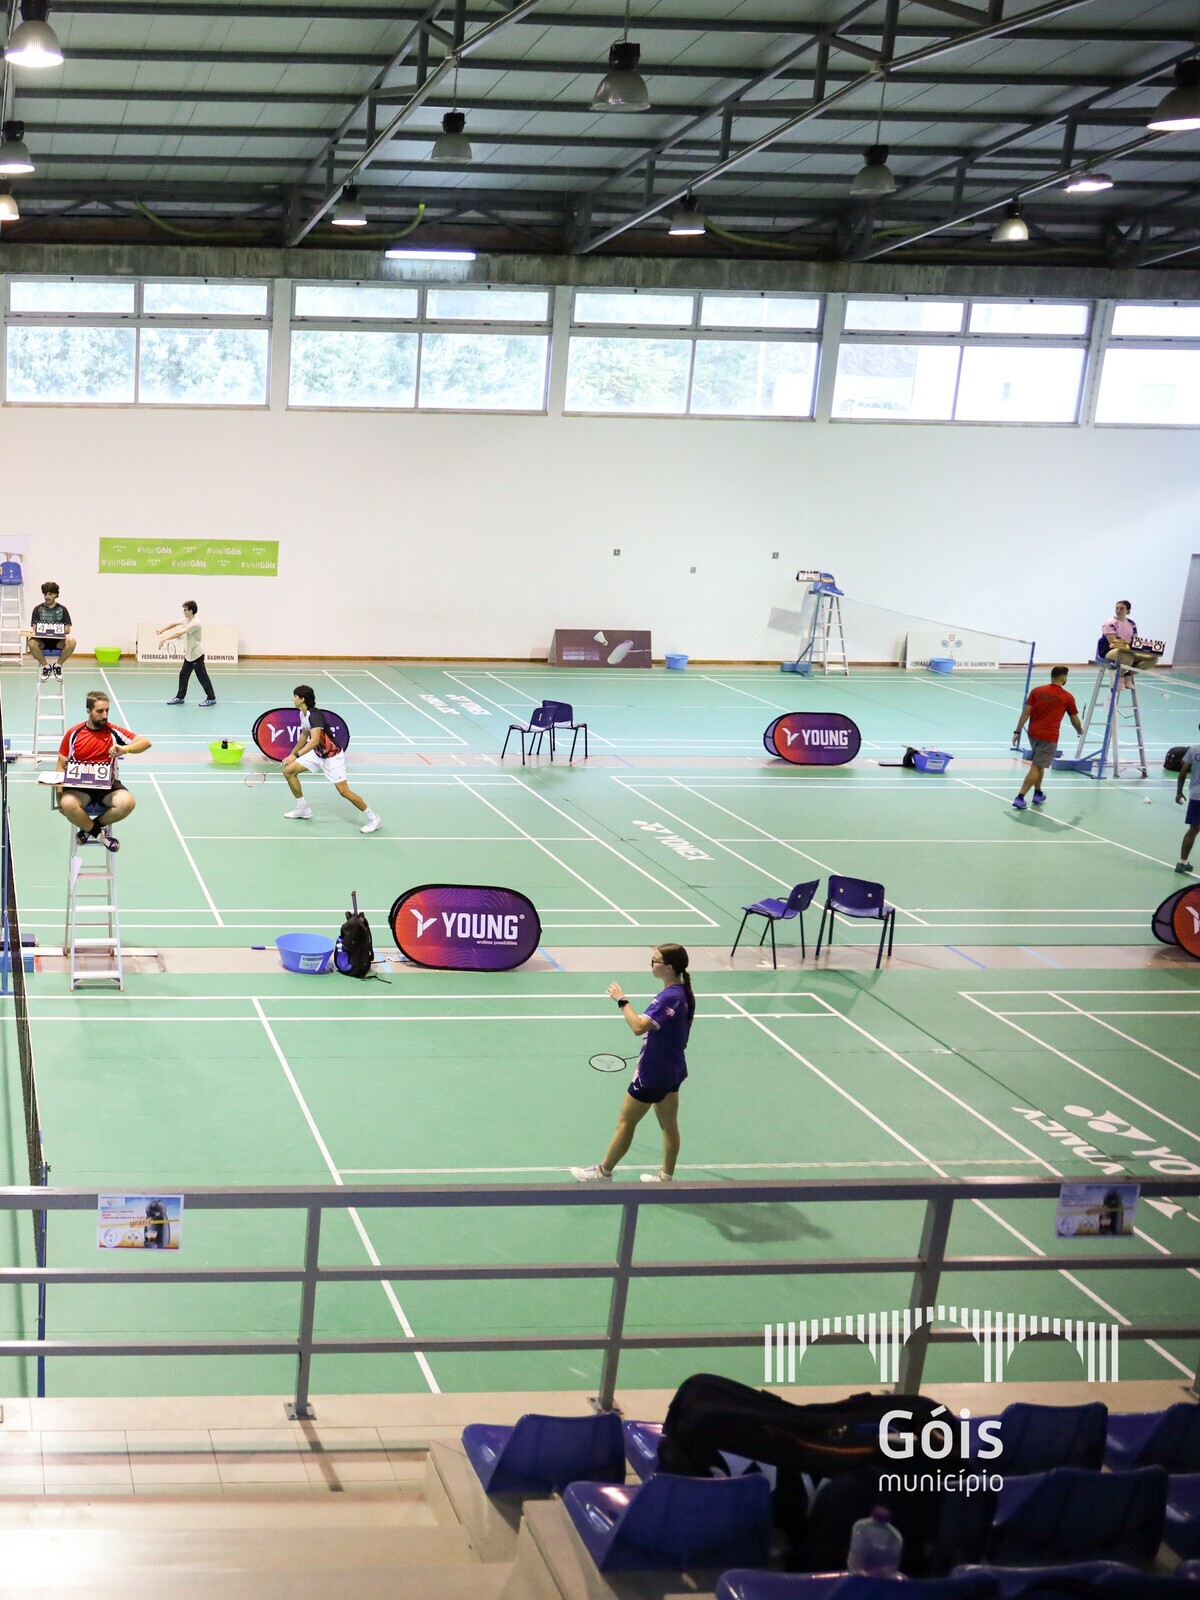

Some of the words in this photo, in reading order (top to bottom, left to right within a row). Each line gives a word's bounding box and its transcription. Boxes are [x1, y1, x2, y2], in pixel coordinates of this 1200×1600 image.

[137, 546, 172, 554] #VisitGóis
[207, 547, 242, 555] #VisitGóis
[241, 561, 276, 569] #VisitGóis
[68, 765, 80, 778] 4
[97, 766, 108, 779] 9
[655, 835, 716, 861] YONEX
